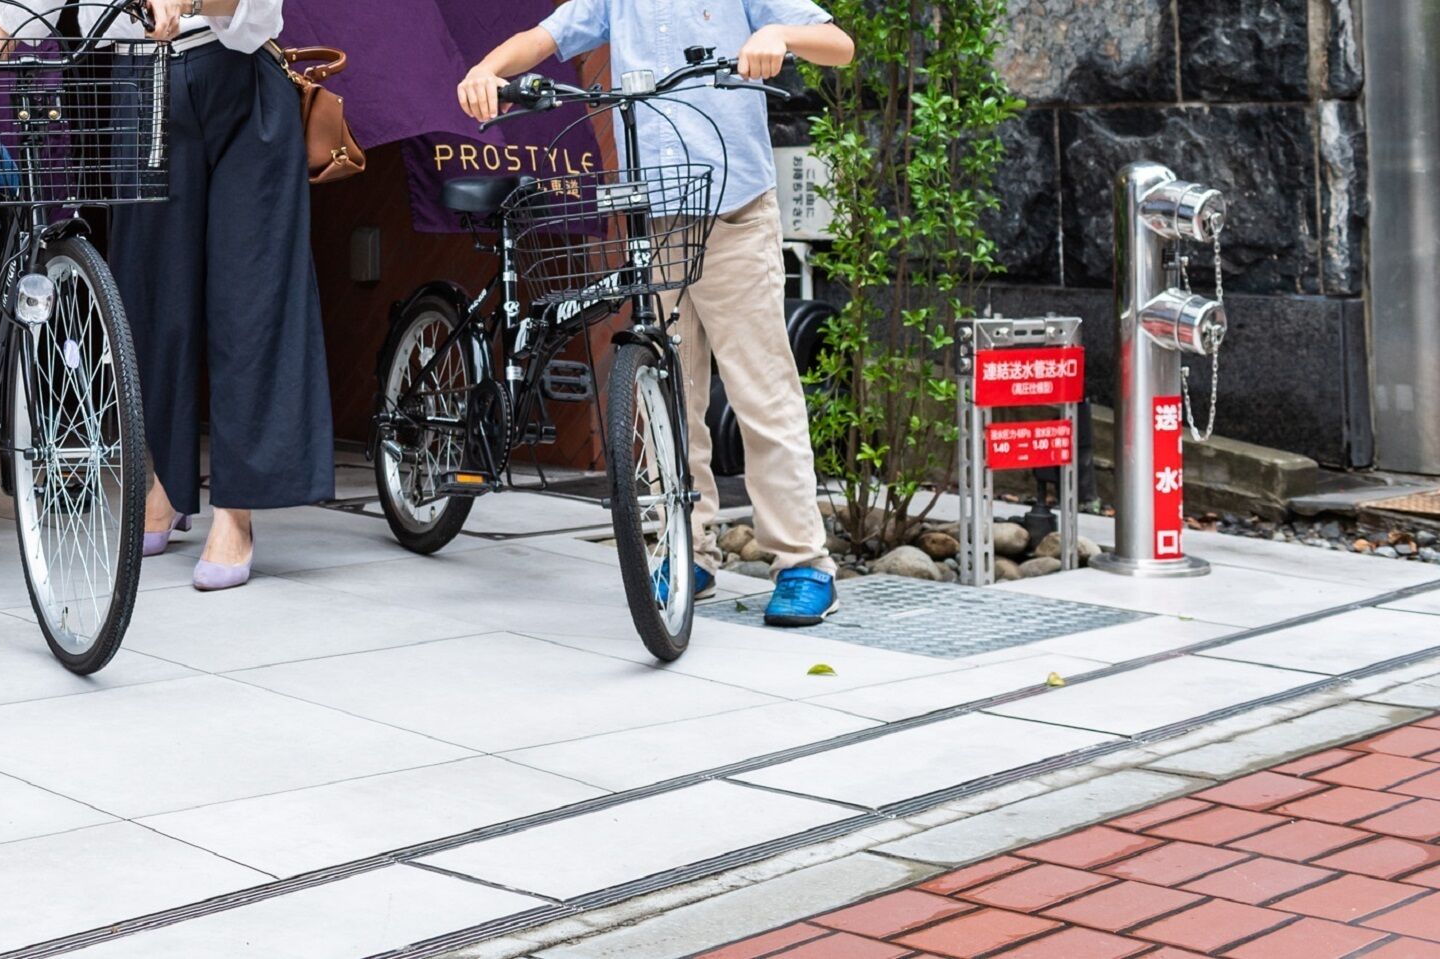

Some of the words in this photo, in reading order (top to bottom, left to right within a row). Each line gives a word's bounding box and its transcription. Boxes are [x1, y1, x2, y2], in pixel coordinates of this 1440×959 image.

[434, 144, 596, 177] PROSTYLE
[982, 359, 1078, 381] 連結送水管送水口
[1155, 404, 1179, 556] 送水口
